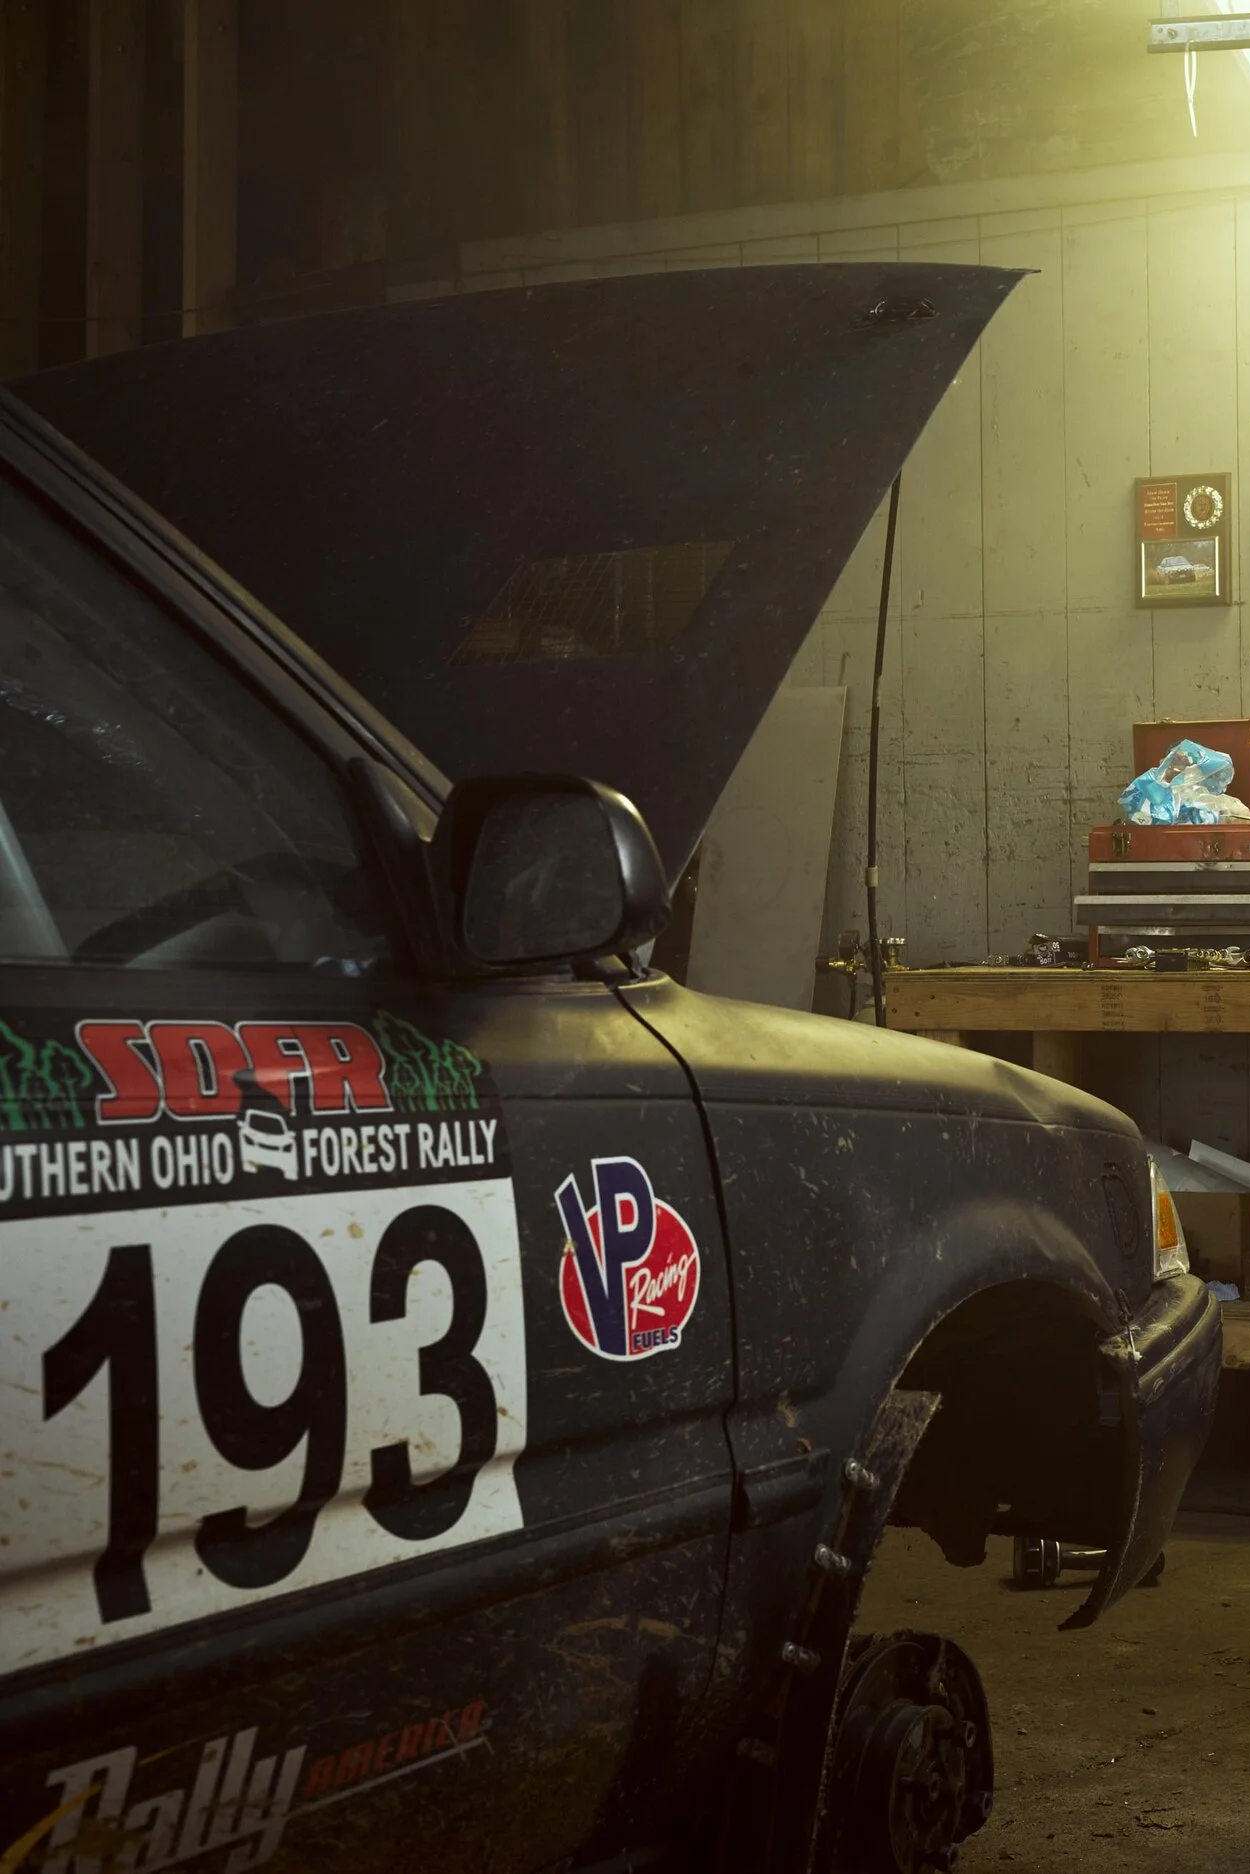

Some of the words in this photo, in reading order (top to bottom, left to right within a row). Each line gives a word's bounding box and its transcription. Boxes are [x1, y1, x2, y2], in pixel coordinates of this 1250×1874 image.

[74, 1018, 394, 1126] SOFR
[151, 1133, 235, 1190] OHIO
[303, 1124, 411, 1177] FOREST
[418, 1119, 498, 1169] RALLY
[553, 1156, 659, 1360] VP
[629, 1252, 698, 1331] Racing
[632, 1327, 680, 1351] FUELS
[42, 1204, 499, 1623] 193
[44, 1725, 308, 1874] Rally
